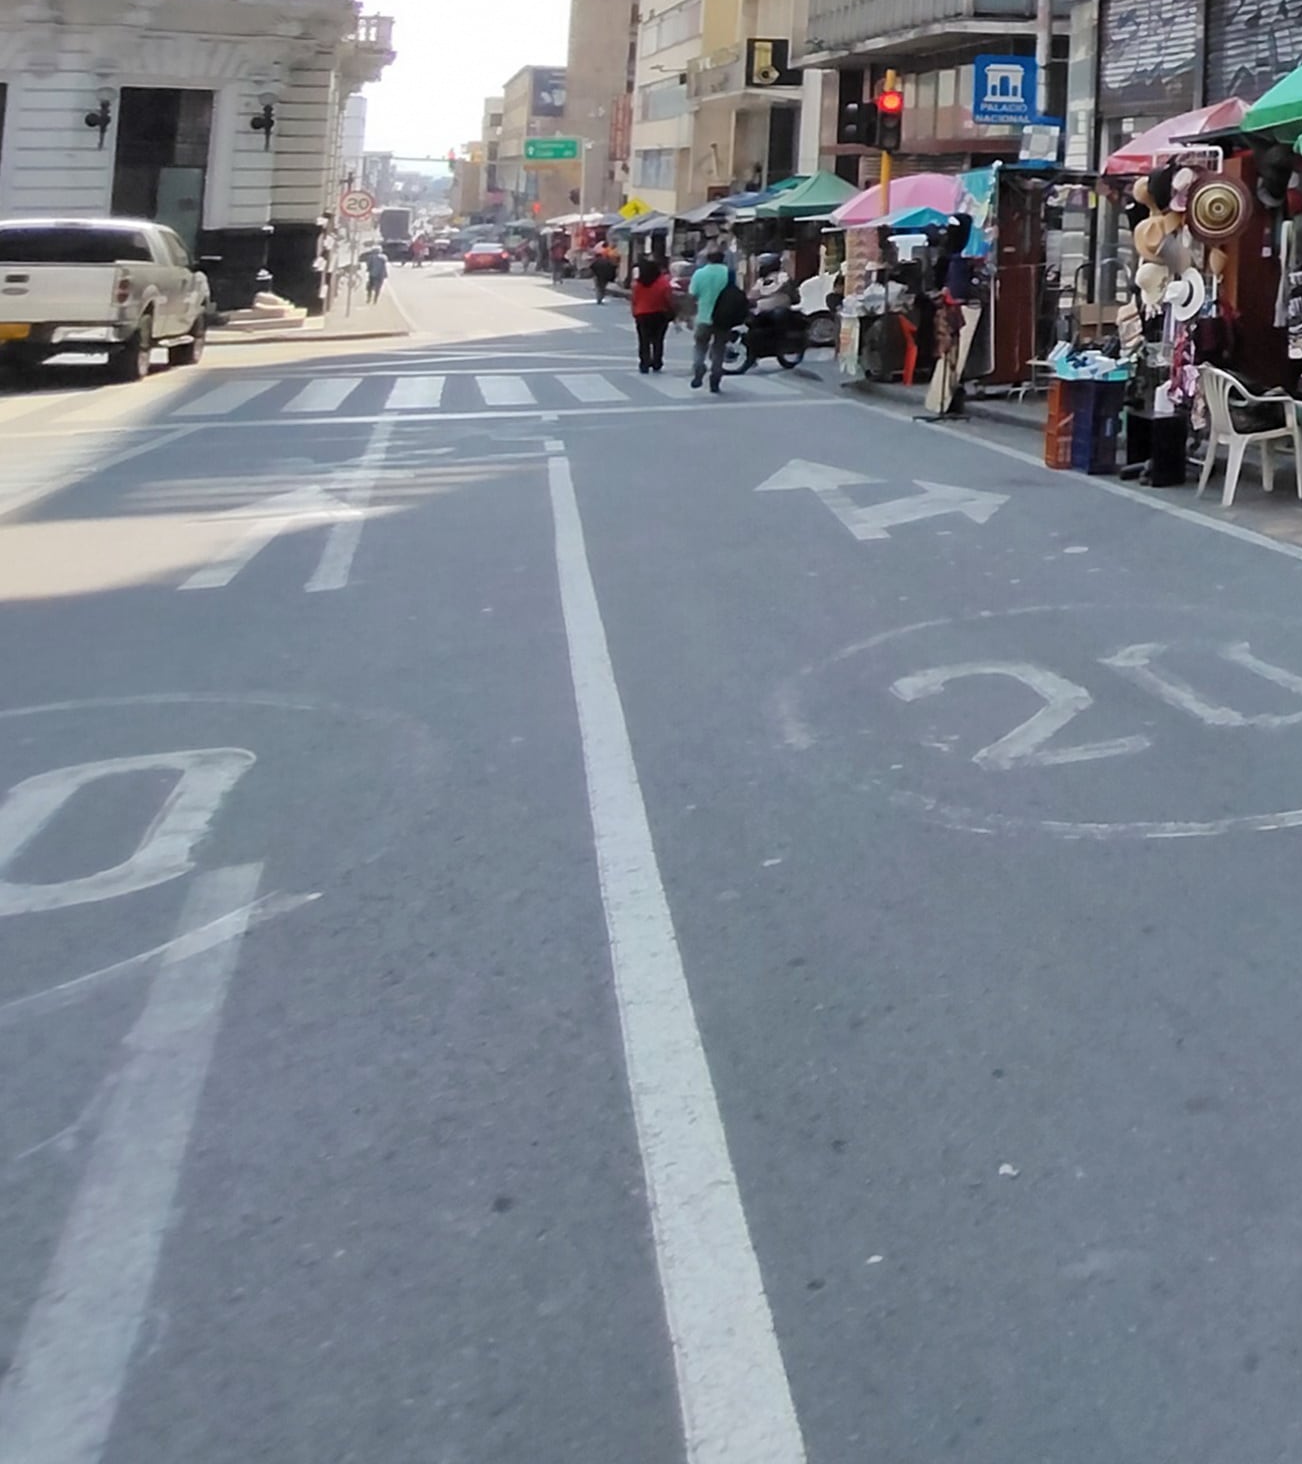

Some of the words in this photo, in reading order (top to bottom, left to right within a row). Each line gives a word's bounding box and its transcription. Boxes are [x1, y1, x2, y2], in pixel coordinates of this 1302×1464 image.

[980, 102, 1028, 114] PALACIO
[975, 113, 1031, 124] NACIONAL
[346, 197, 370, 210] 20
